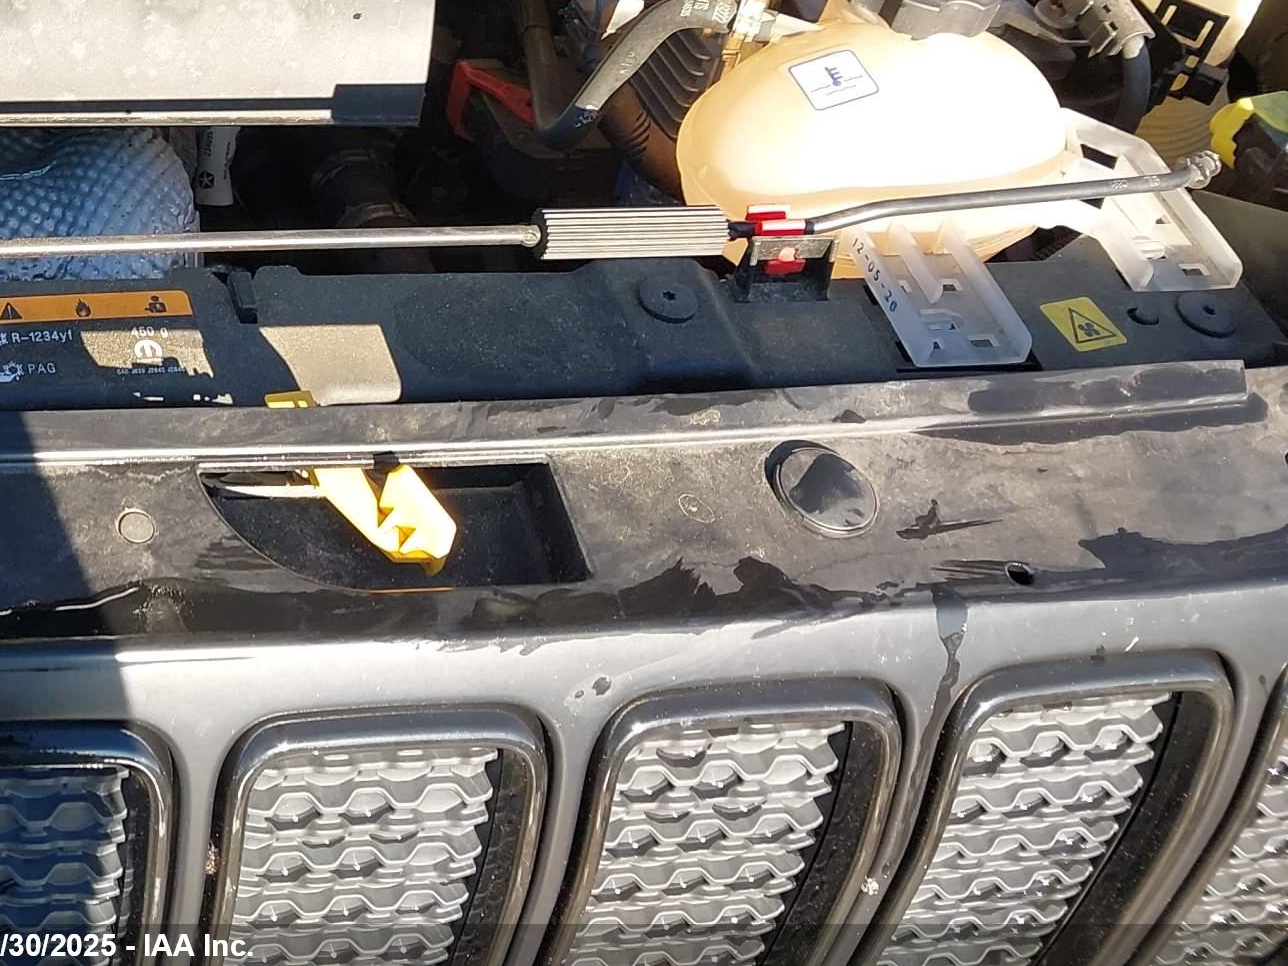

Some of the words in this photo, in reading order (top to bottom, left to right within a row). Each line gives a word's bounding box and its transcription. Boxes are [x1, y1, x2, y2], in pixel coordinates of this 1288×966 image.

[852, 238, 898, 312] 12-05-20
[130, 326, 154, 339] 450
[27, 363, 56, 374] PAG
